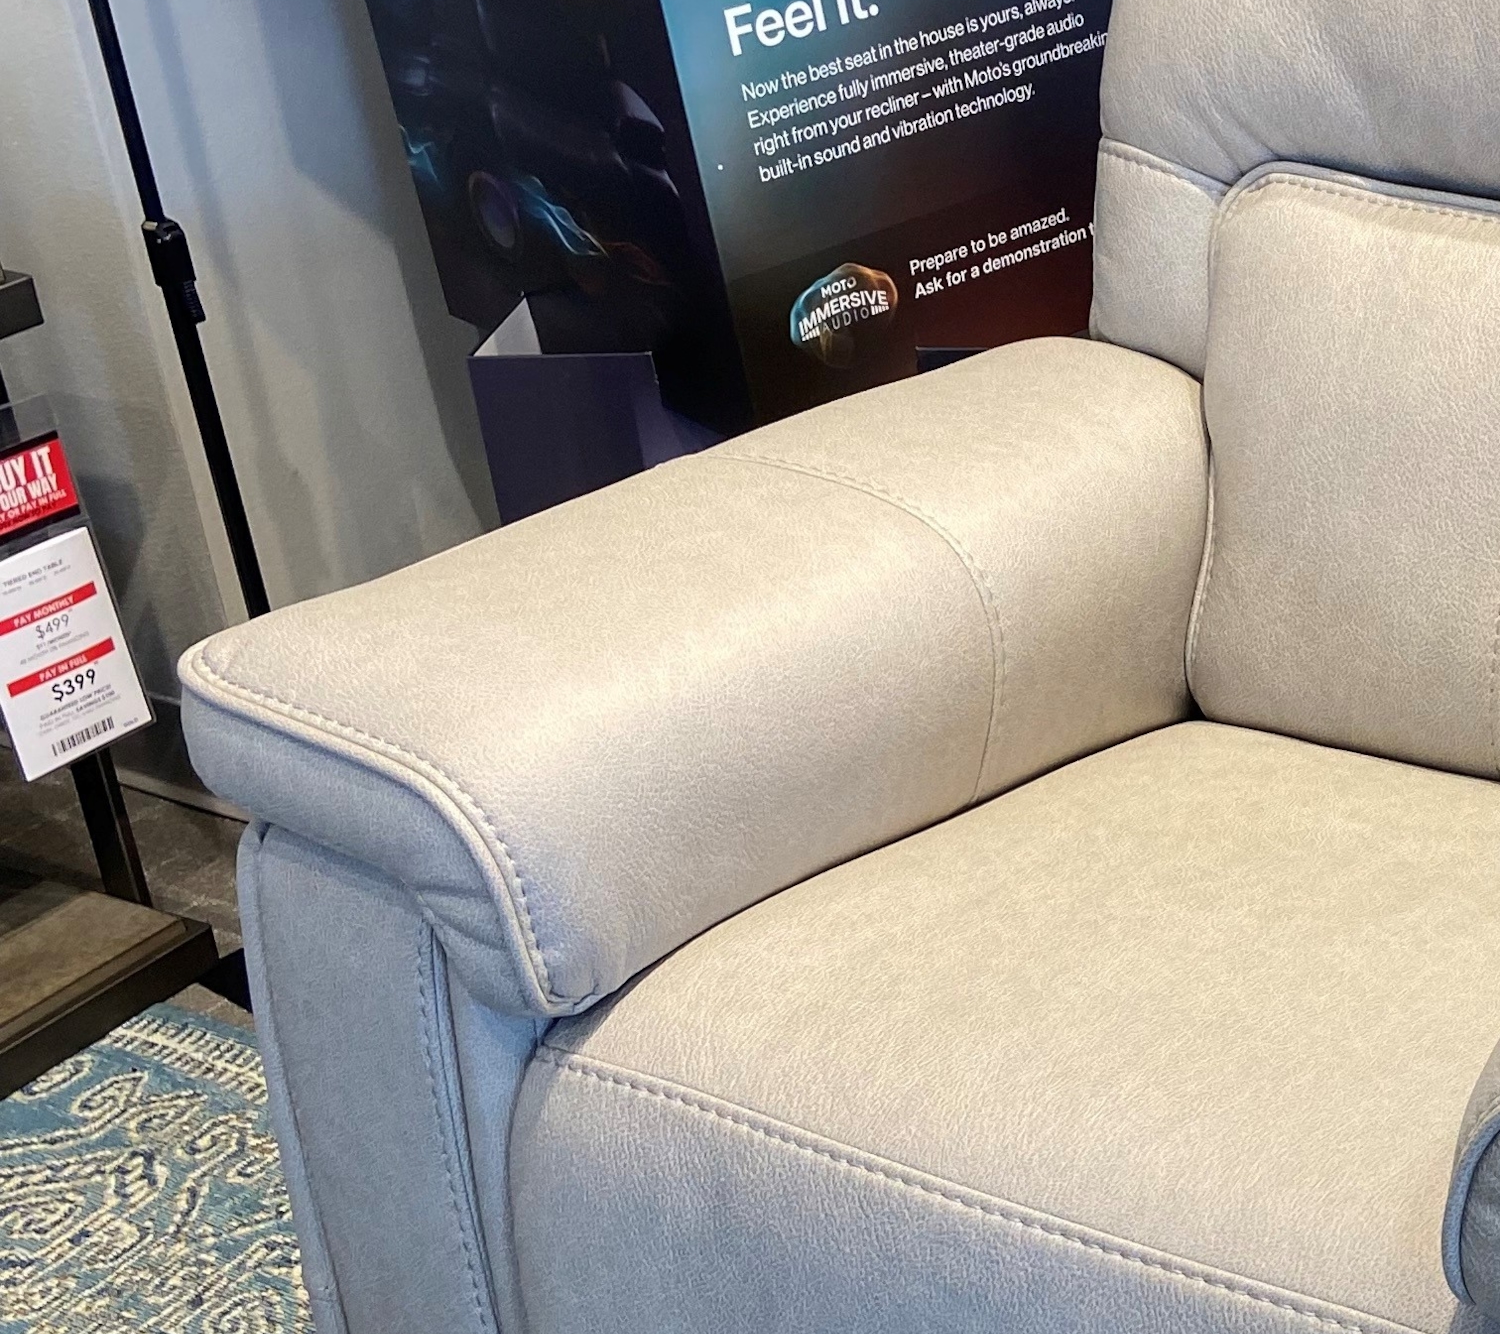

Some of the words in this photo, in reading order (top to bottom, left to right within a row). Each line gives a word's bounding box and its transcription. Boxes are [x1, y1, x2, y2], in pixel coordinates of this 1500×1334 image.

[740, 78, 779, 102] Now
[780, 71, 807, 91] the
[807, 57, 844, 83] best
[844, 46, 878, 71] seat
[878, 43, 893, 60] in
[893, 36, 919, 55] the
[919, 22, 965, 48] house
[965, 17, 979, 34] is
[978, 5, 1024, 33] yours,
[747, 90, 837, 129] Experience
[837, 77, 869, 101] fully
[870, 56, 948, 92] immersive,
[949, 25, 1046, 66] theater-grade
[1046, 12, 1084, 37] audio
[753, 130, 791, 156] right
[791, 121, 829, 144] from
[828, 109, 862, 136] your
[865, 91, 920, 122] recliner
[932, 77, 964, 99] with
[964, 61, 1012, 90] Moto's
[1012, 30, 1108, 77] groundbreakin
[758, 154, 813, 183] built-in
[814, 136, 861, 165] sound
[862, 125, 891, 150] and
[891, 109, 954, 140] vibration
[954, 83, 1036, 120] technology.
[909, 244, 968, 276] Prepare
[970, 238, 986, 254] to
[987, 231, 1007, 249] be
[1009, 207, 1070, 241] amazed.
[914, 275, 945, 299] Ask
[946, 268, 967, 287] for
[970, 265, 981, 279] a
[982, 227, 1087, 276] demonstration
[820, 276, 857, 298] MOTO
[798, 290, 889, 337] IMMERSIVE
[822, 307, 870, 334] AUDIO
[0, 455, 27, 491] UY
[30, 445, 53, 480] IT
[0, 486, 28, 511] OUR
[27, 473, 58, 499] WAY
[33, 595, 75, 618] MONTHLY
[35, 613, 69, 640] $499
[52, 668, 96, 702] $399
